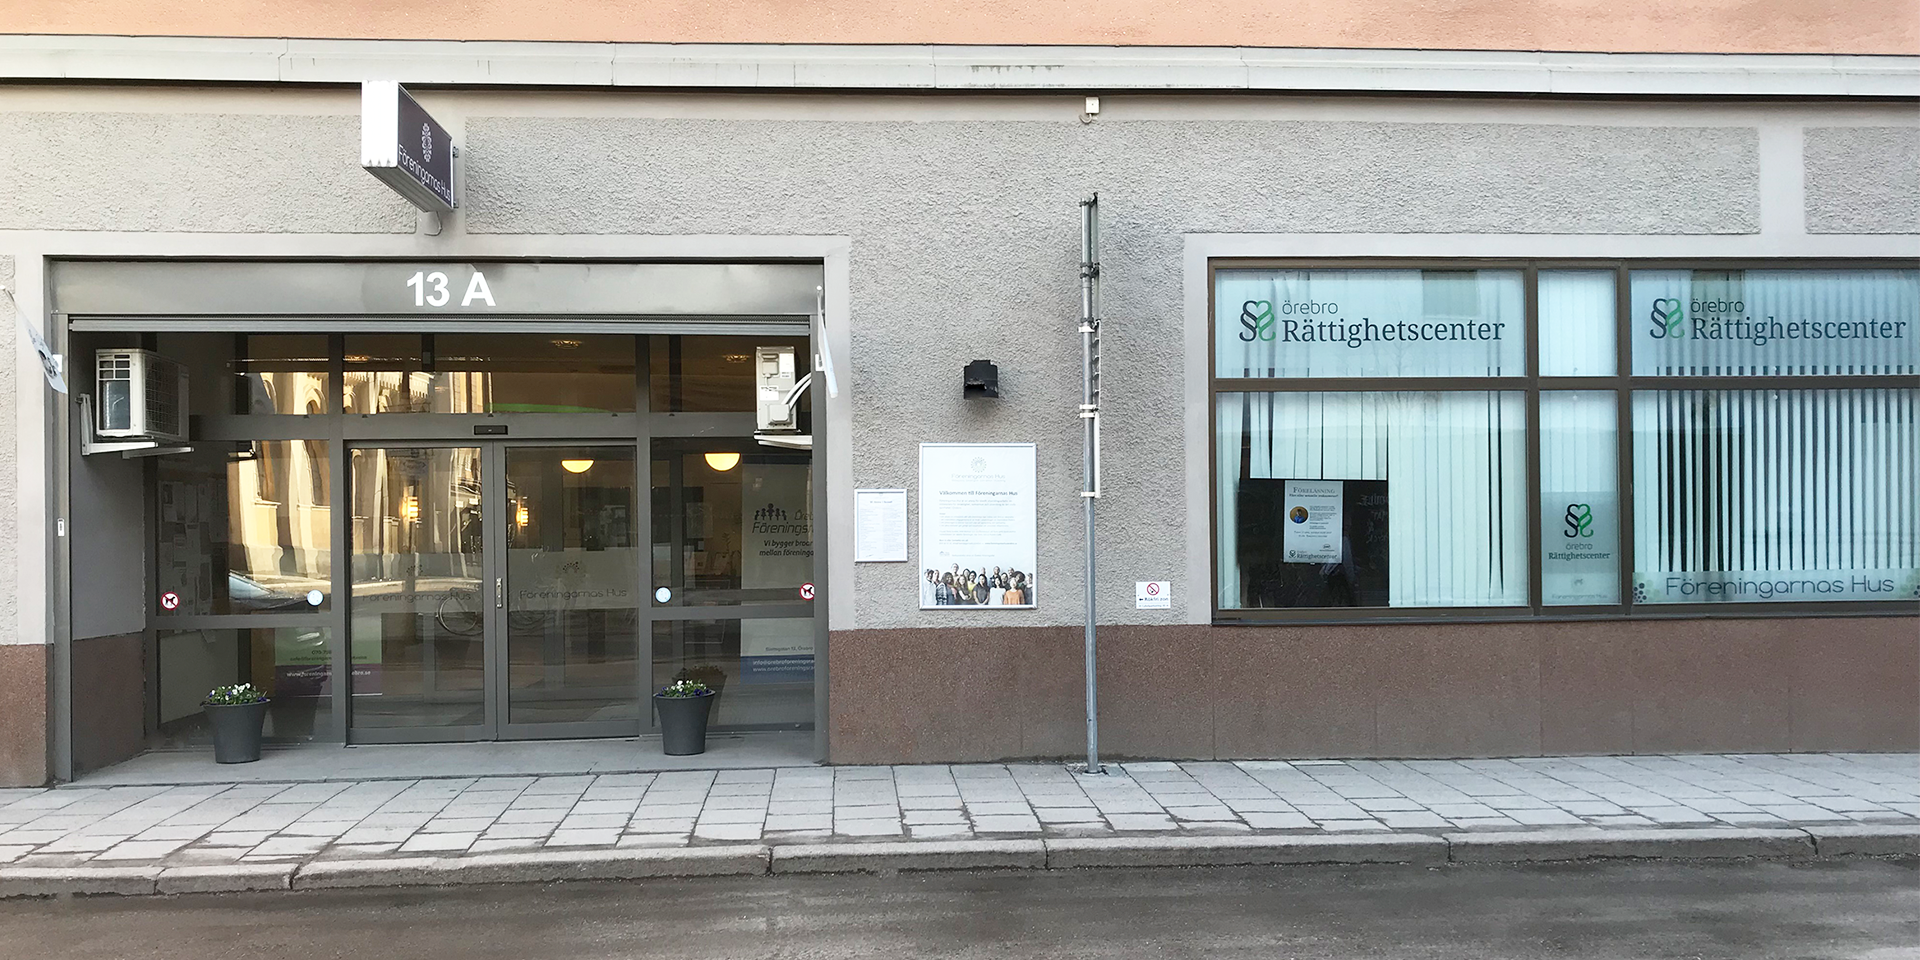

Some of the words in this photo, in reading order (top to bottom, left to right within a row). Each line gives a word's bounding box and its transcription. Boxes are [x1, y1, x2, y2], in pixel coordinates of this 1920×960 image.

[399, 143, 440, 192] Föreningarnas
[441, 179, 451, 202] Hus
[407, 271, 450, 307] 13
[460, 271, 496, 307] A
[1282, 299, 1339, 315] örebro
[1690, 298, 1745, 313] örebro
[1282, 318, 1505, 348] Rättighetscenter
[1690, 316, 1907, 347] Rättighetscenter
[772, 540, 794, 548] bygger
[1565, 542, 1593, 550] örebro
[1548, 552, 1611, 561] Rättighetscenter
[1666, 577, 1844, 599] Föreningarnas
[1851, 574, 1895, 593] Hus
[451, 592, 471, 600] Hus
[519, 589, 604, 601] Föreningarnas
[606, 588, 627, 598] Hus
